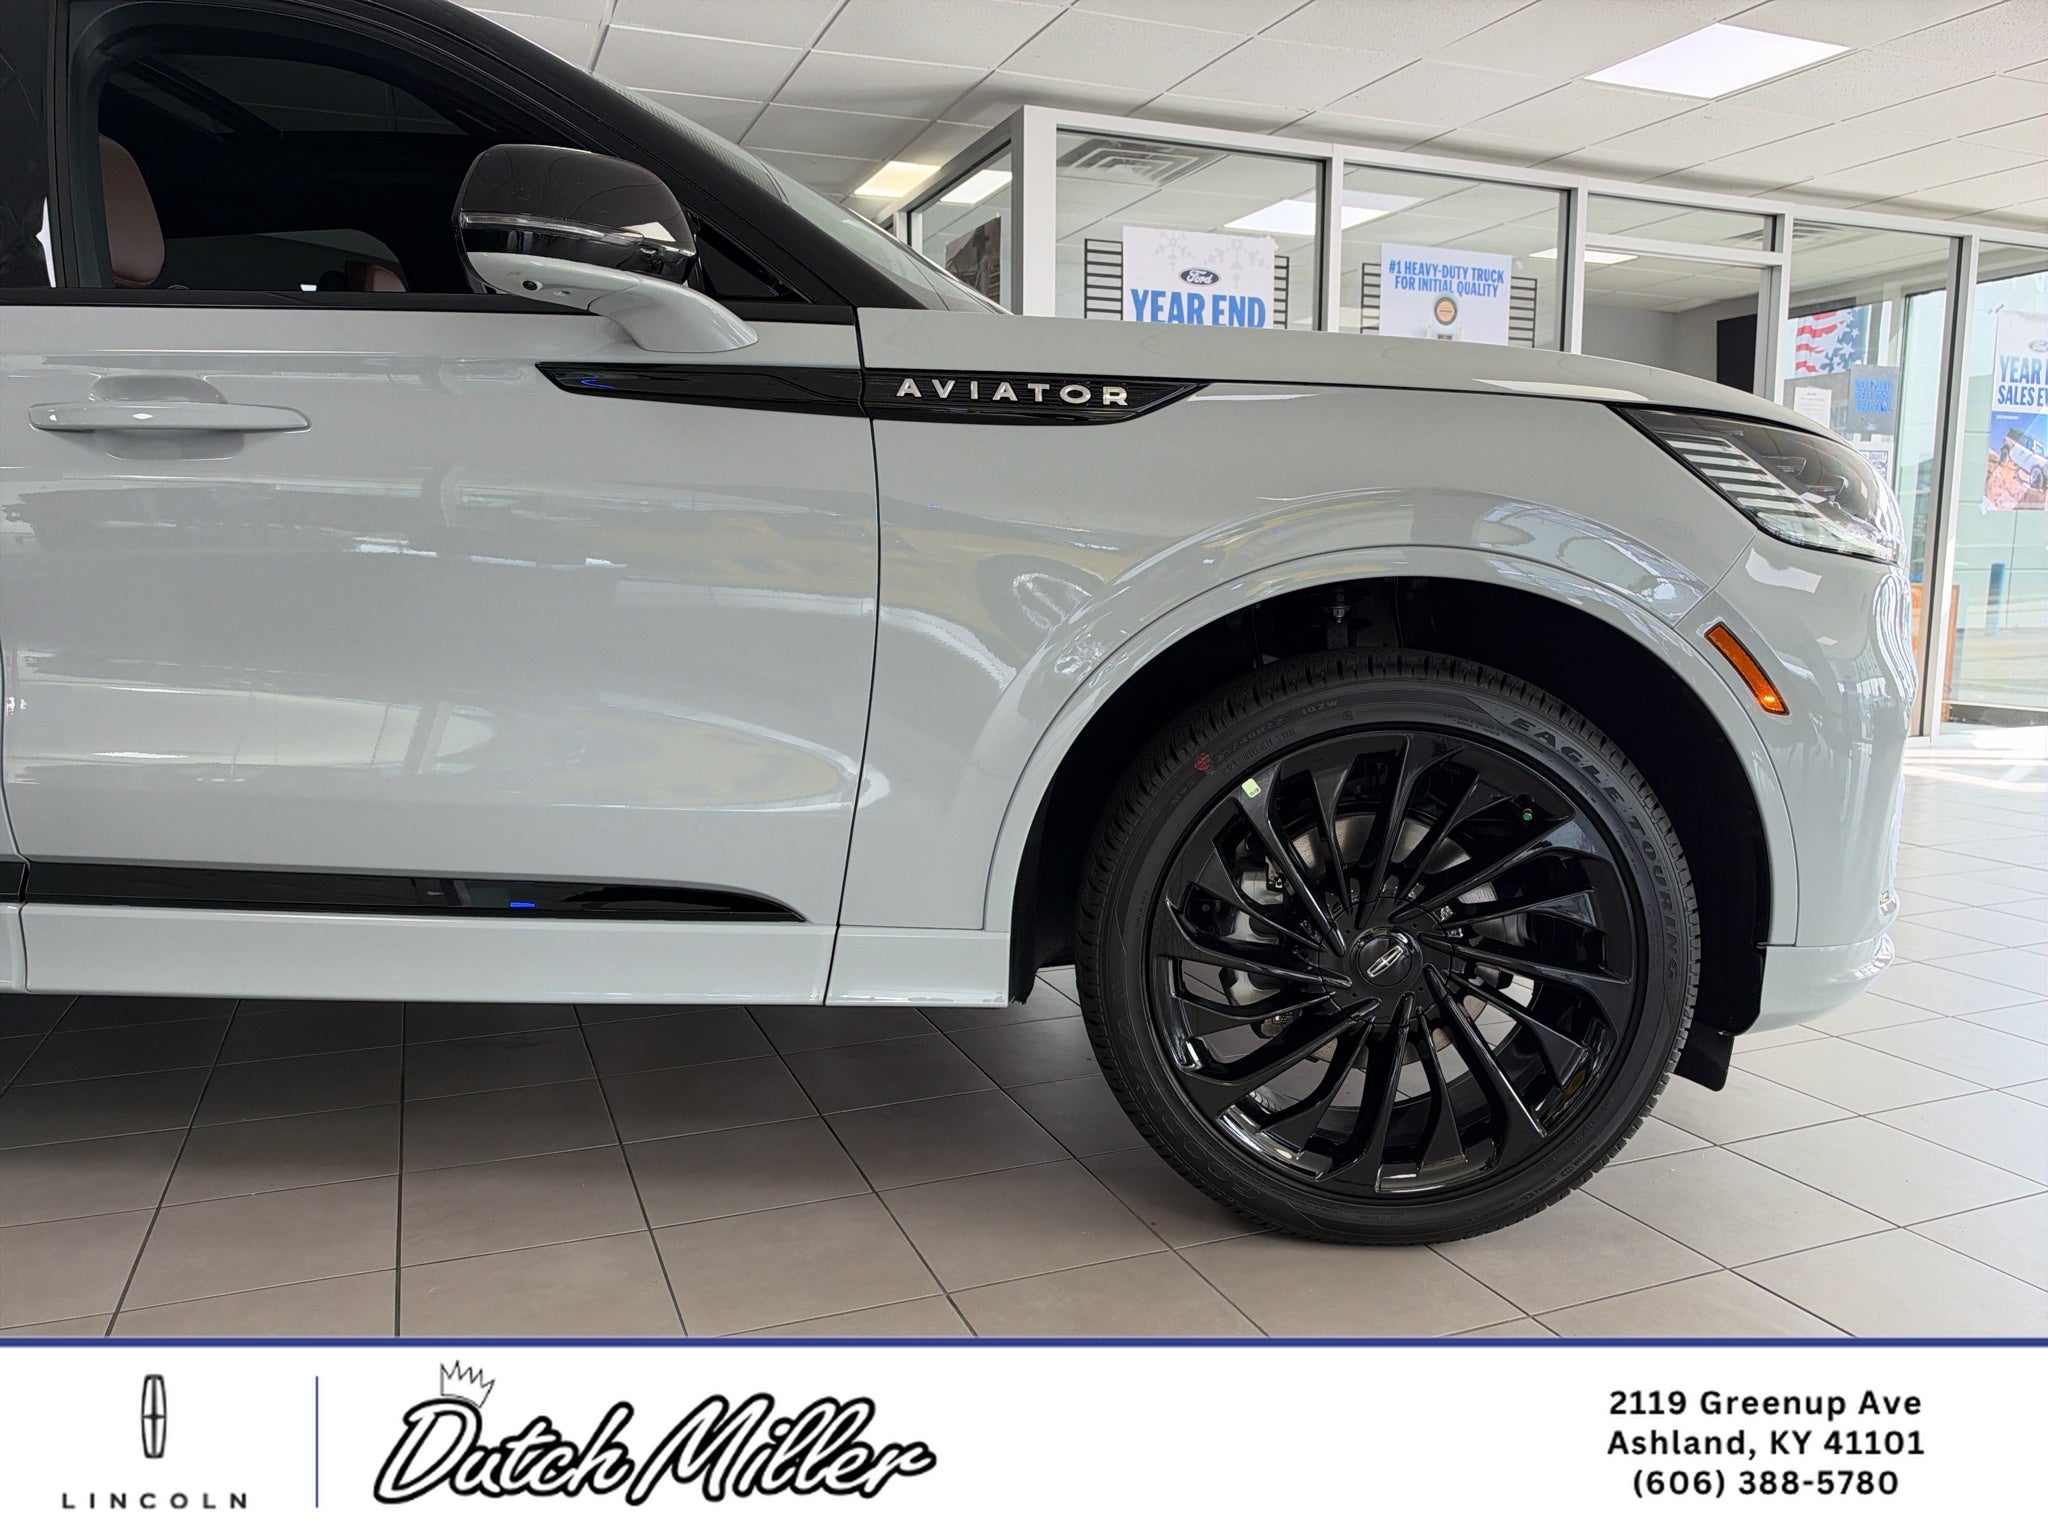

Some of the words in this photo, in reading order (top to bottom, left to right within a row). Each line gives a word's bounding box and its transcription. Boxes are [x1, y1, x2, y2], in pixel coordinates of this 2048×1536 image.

[1185, 269, 1215, 285] Ford
[1389, 260, 1402, 274] #1
[1404, 261, 1469, 280] HEAVY-DUTY
[1471, 267, 1504, 284] TRUCK
[1395, 275, 1416, 290] FOR
[1418, 278, 1454, 294] INITIAL
[1457, 281, 1499, 298] QUALITY
[1130, 288, 1206, 325] YEAR
[1212, 294, 1266, 328] END
[1999, 355, 2042, 385] YEAR
[896, 378, 1128, 406] AVIATOR
[1998, 385, 2035, 406] SALES
[1510, 717, 1626, 804] EAGLE
[1627, 815, 1679, 981] TOURING
